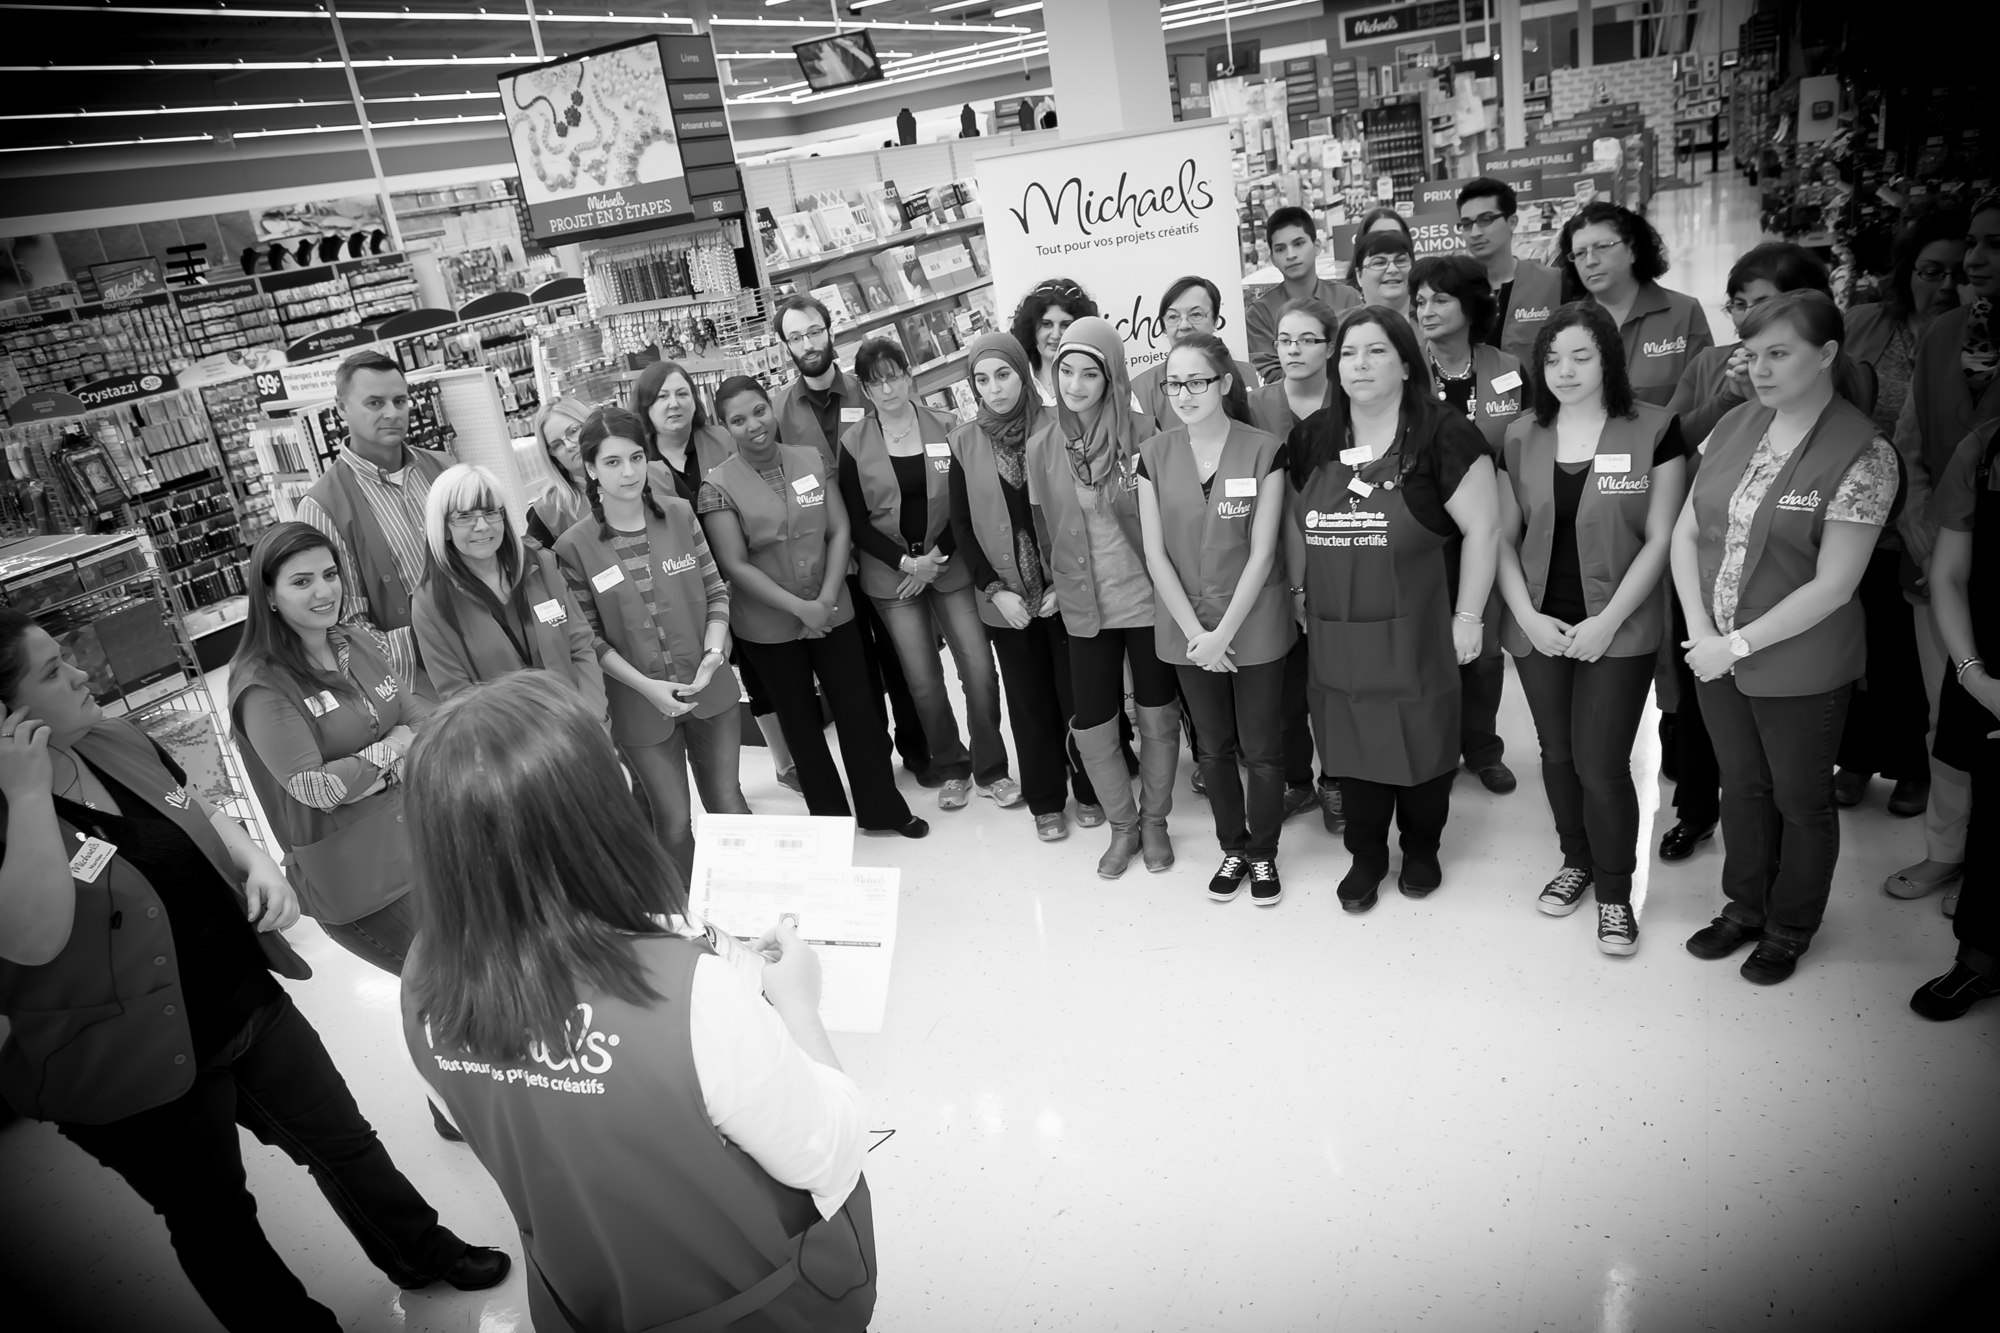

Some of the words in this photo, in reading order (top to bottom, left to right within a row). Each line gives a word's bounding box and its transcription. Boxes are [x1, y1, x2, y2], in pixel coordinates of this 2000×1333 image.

[680, 53, 700, 63] Livres
[682, 92, 710, 101] Instruction
[1486, 160, 1509, 171] PRIX
[1510, 152, 1574, 169] IMBATTABLE
[586, 191, 626, 212] Michaels
[1009, 158, 1214, 236] Michaels
[1423, 189, 1452, 203] PRIX
[712, 200, 724, 213] 82
[549, 212, 594, 233] PROJET
[597, 208, 613, 225] EN
[615, 207, 624, 221] 3
[625, 198, 673, 220] ÉTAPES
[1036, 242, 1062, 257] Tout
[1064, 239, 1092, 255] pour
[1094, 237, 1113, 248] vos
[1115, 230, 1156, 247] projets
[1158, 222, 1199, 239] créatifs
[1407, 223, 1449, 240] OSES
[1414, 237, 1467, 253] AIMON
[102, 298, 144, 310] fournitures
[1514, 305, 1551, 319] Michaels
[1642, 335, 1688, 355] Michaels
[1131, 352, 1169, 366] projets
[78, 381, 139, 405] Crystazzi
[256, 374, 281, 396] 99¢
[1597, 475, 1651, 491] Michaels
[1778, 489, 1822, 508] chaels
[1306, 534, 1351, 546] Instructeur
[1353, 533, 1389, 546] certifié
[70, 842, 100, 873] Michaels
[853, 873, 885, 885] Michaels
[434, 1055, 462, 1072] Tout
[462, 1060, 491, 1076] pour
[491, 1067, 505, 1081] os
[506, 1068, 549, 1087] prjets
[550, 1077, 605, 1095] créatifs
